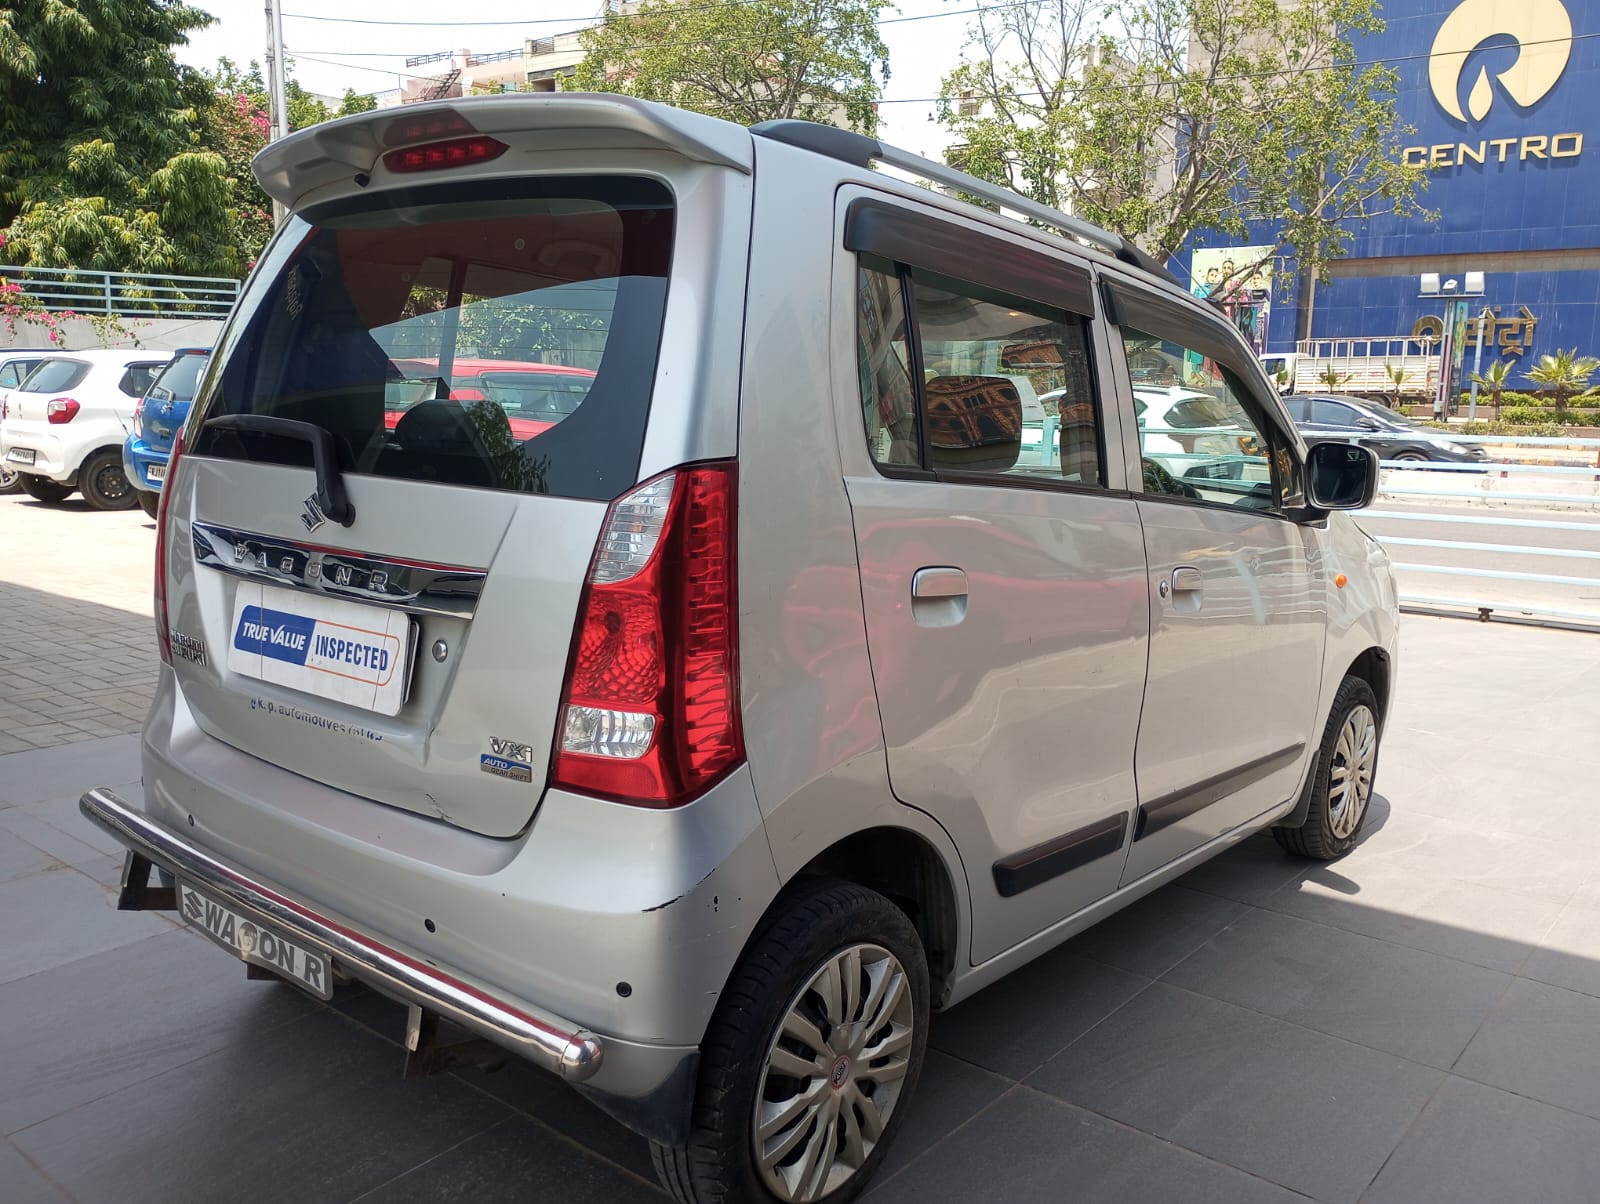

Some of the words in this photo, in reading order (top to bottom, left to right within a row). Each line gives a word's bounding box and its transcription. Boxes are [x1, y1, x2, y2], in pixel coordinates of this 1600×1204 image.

[1402, 132, 1583, 168] CENTRO
[242, 622, 270, 642] TRUE
[270, 624, 306, 651] VALUE
[315, 634, 389, 671] INSPECTED
[484, 758, 508, 769] AUTO
[489, 736, 532, 763] VXi
